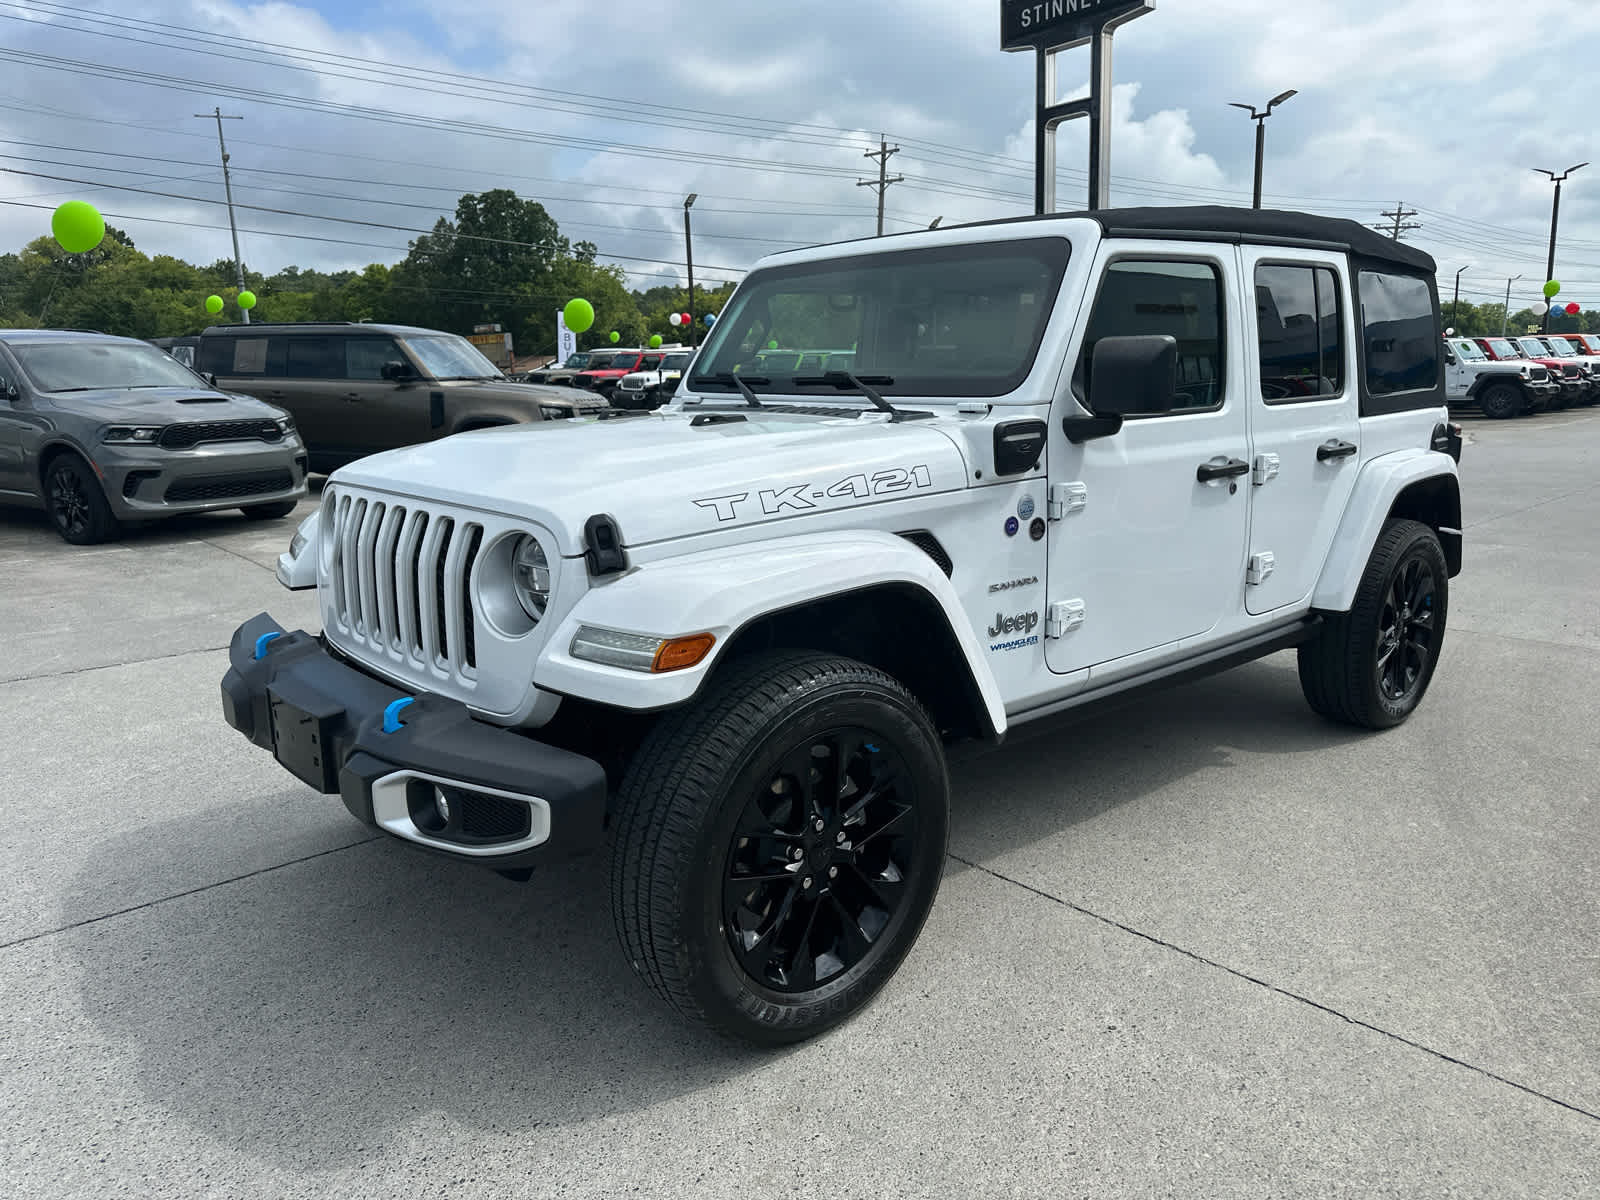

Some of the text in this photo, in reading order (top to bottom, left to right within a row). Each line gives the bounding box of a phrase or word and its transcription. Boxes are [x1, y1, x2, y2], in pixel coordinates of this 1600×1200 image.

[1021, 0, 1100, 27] STINNE
[988, 576, 1039, 593] SAHARA
[988, 610, 1038, 637] Jeep
[990, 635, 1038, 651] WRANGLER
